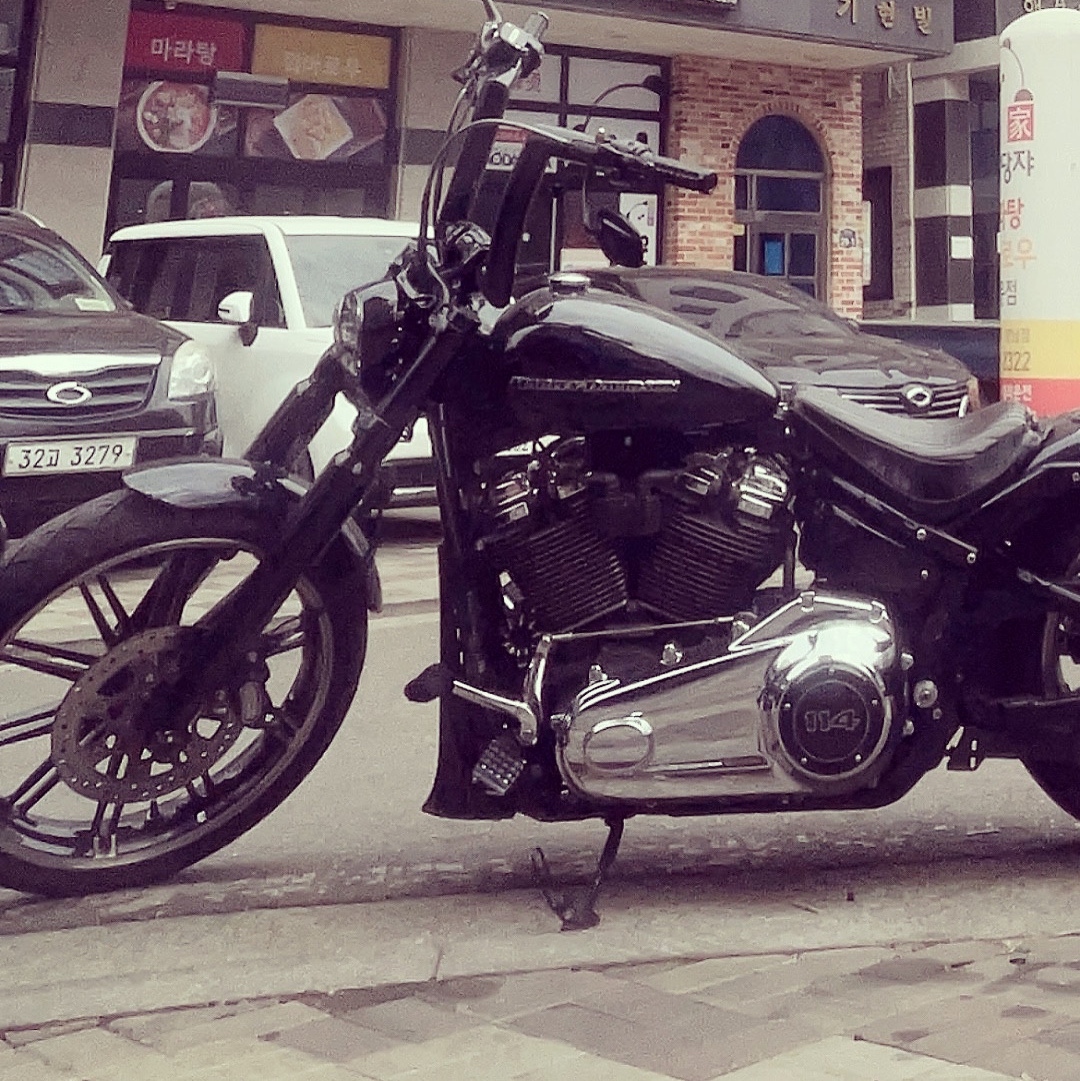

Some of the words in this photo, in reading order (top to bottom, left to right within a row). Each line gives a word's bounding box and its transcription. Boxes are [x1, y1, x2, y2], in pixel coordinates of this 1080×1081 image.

[151, 37, 217, 67] 마라탕
[1009, 106, 1032, 139] 家
[70, 444, 123, 467] 3279
[805, 708, 860, 732] 114
